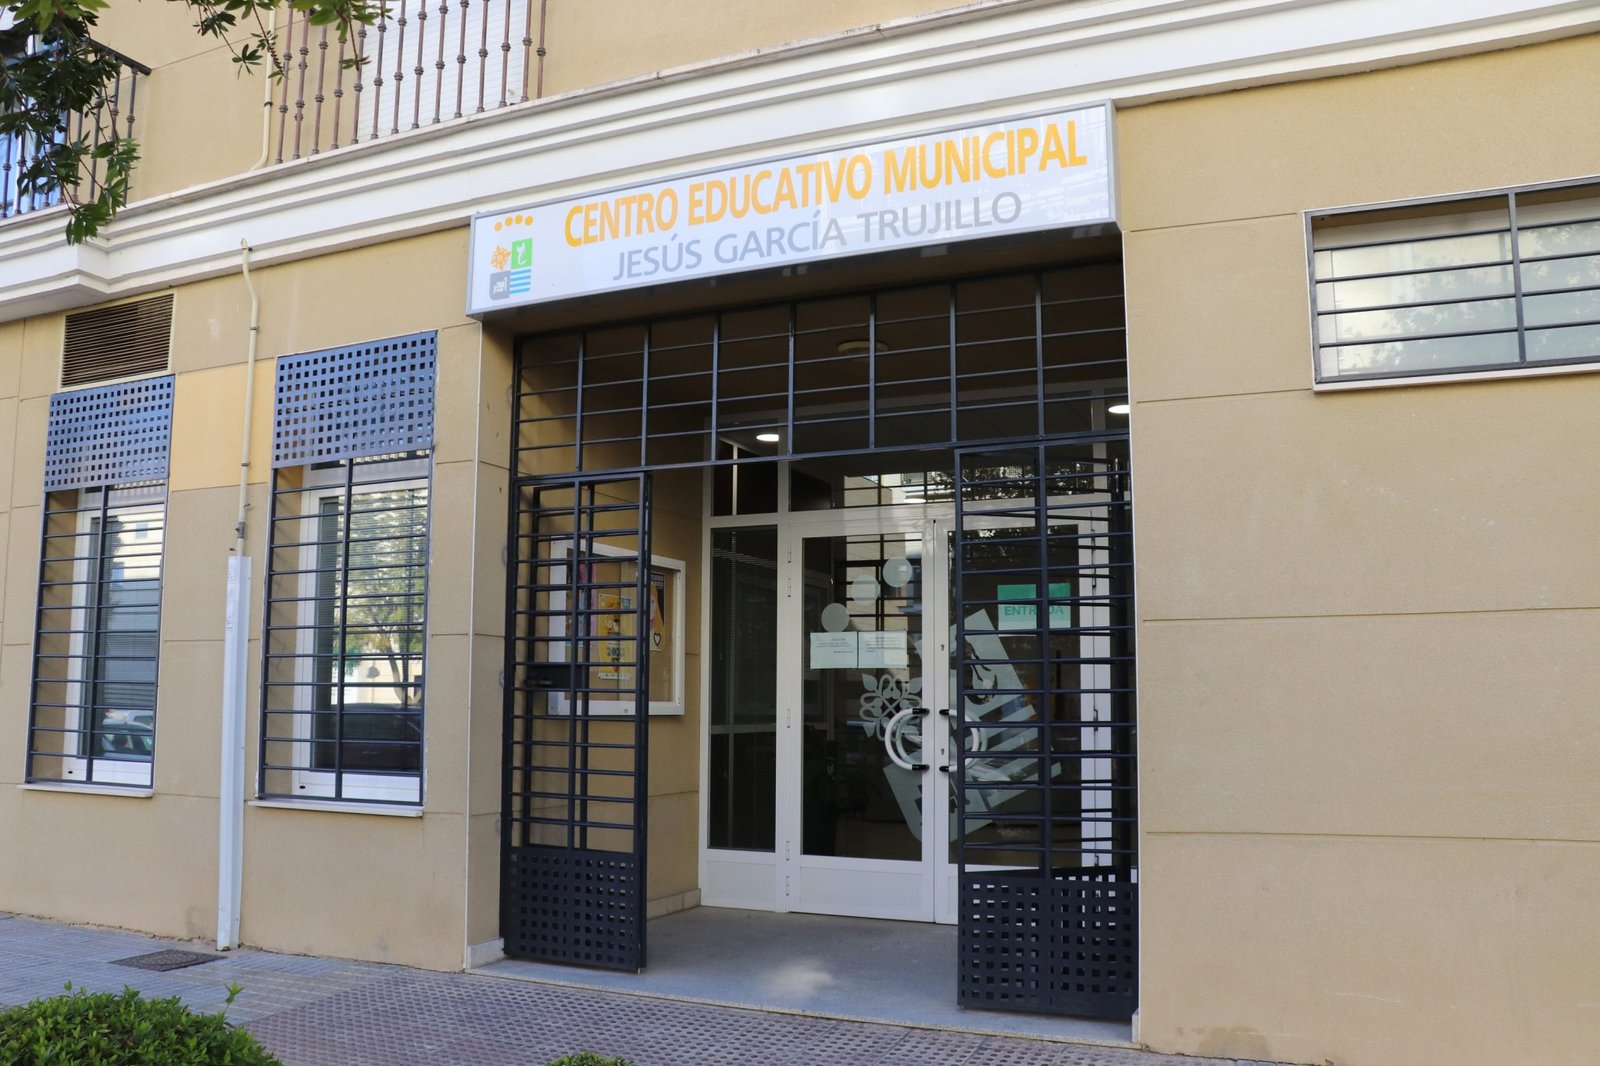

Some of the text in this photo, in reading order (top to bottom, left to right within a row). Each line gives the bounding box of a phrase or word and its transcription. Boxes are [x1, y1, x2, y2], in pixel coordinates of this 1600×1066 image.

[564, 120, 1088, 248] CENTRO EDUCATIVO MUNICIPAL
[612, 191, 1022, 281] JESÚS GARCÍA TRUJILLO
[1004, 605, 1064, 616] ENTRDA
